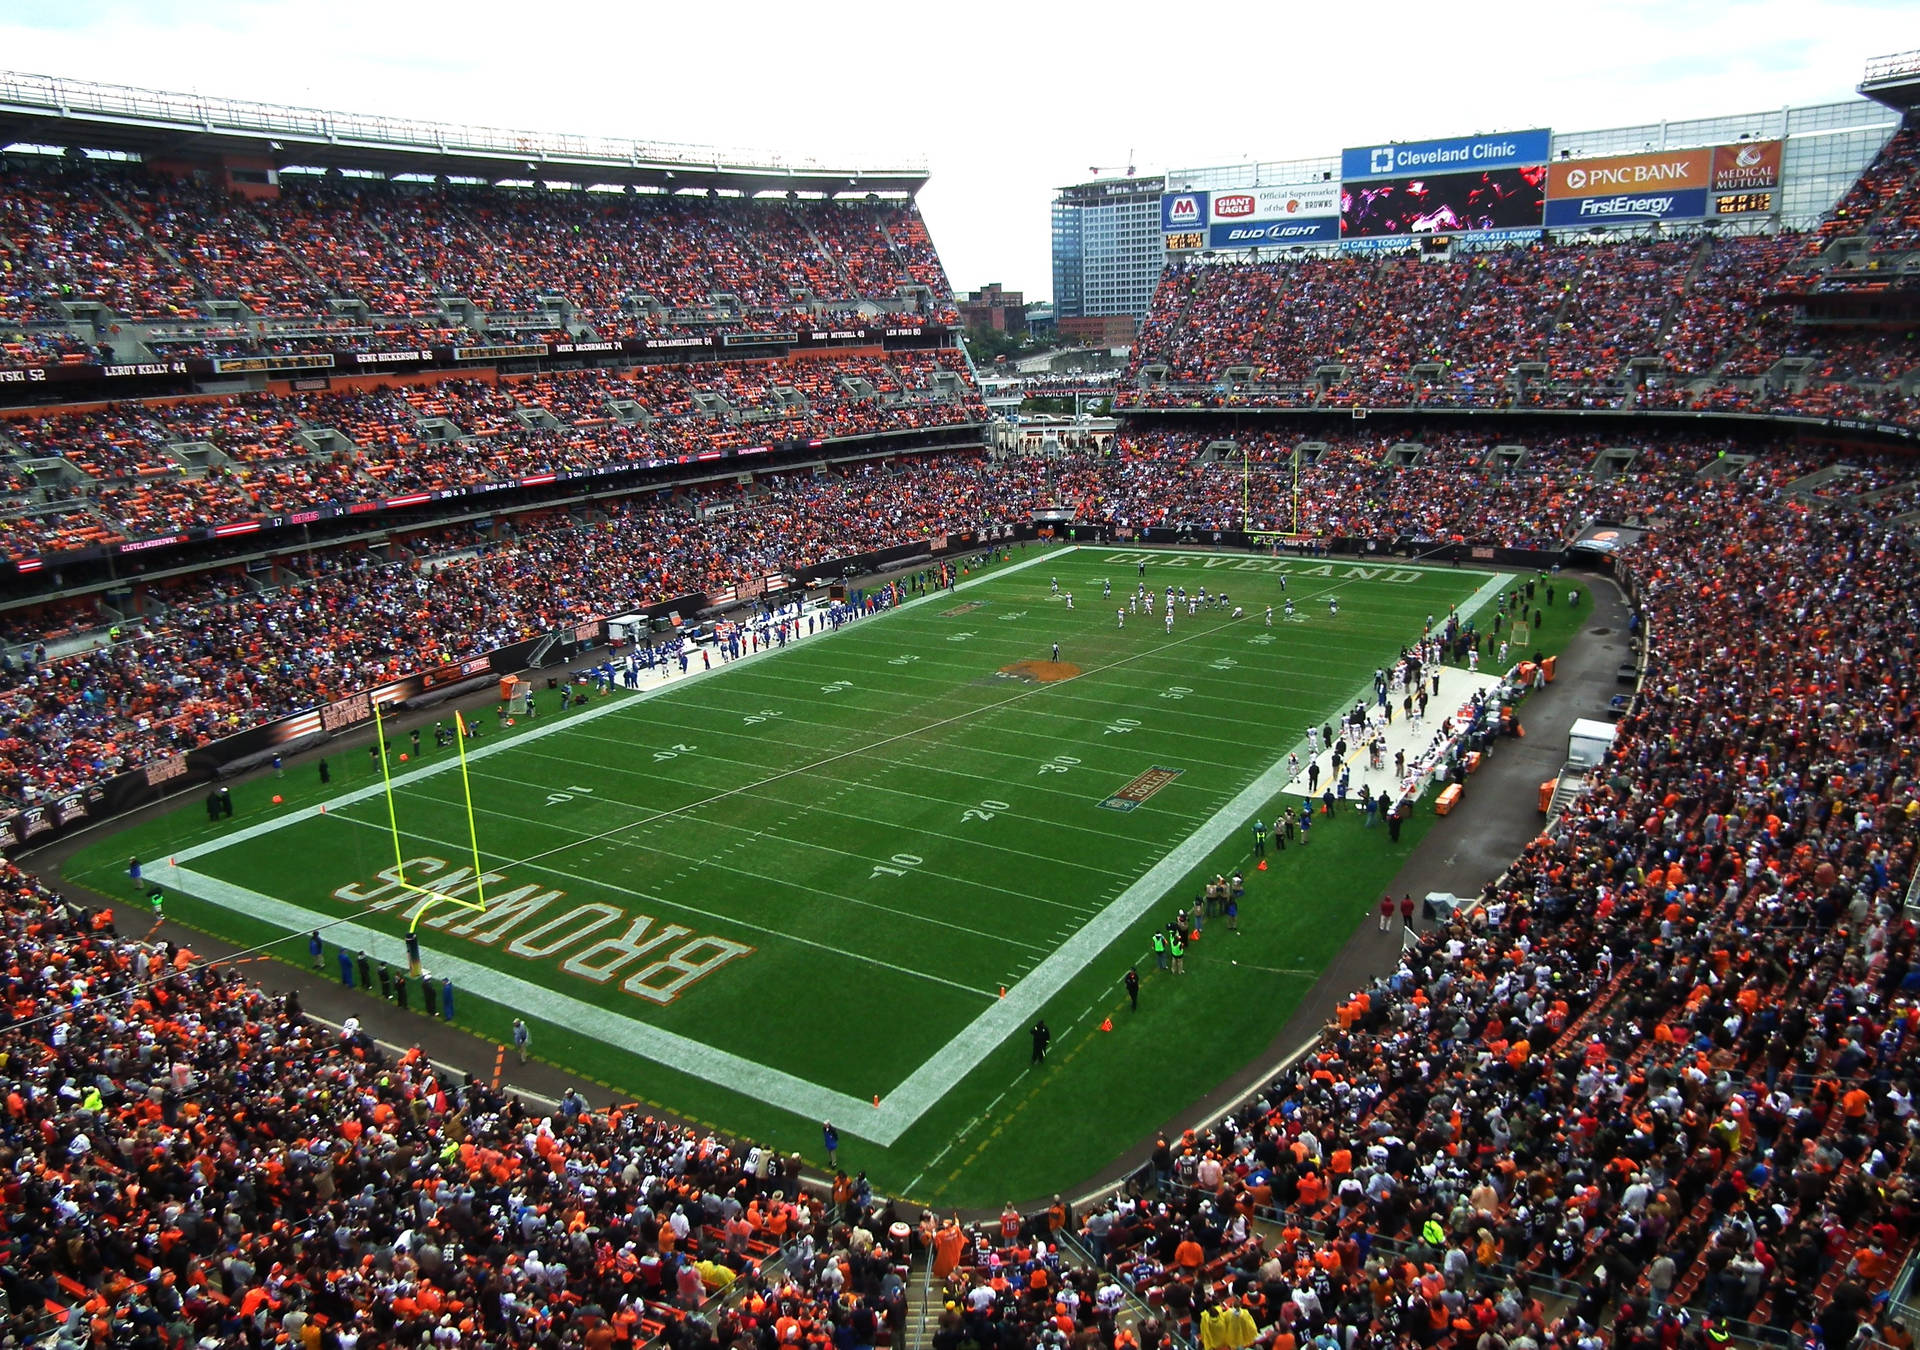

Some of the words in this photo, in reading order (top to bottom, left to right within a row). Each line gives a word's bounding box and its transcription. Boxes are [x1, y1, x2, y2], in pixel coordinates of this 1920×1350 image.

[1397, 147, 1469, 166] Cleveland
[1472, 142, 1516, 159] Clinic
[1590, 166, 1632, 185] PNC
[1634, 162, 1690, 181] BANK
[1717, 167, 1773, 179] MEDICAL
[1716, 178, 1773, 190] MUTUAL
[1259, 191, 1288, 200] Official
[1288, 188, 1338, 200] Supermarket
[1218, 197, 1250, 207] GIANT
[1264, 204, 1272, 212] of
[1273, 204, 1285, 212] the
[1304, 200, 1333, 210] BROWNS
[1580, 197, 1674, 215] FirstEnergy
[1218, 205, 1250, 214] EAGLE
[1229, 228, 1266, 240] BUD
[1271, 225, 1321, 237] LIGHT
[1351, 240, 1375, 249] CALL
[1376, 238, 1409, 247] TODAY
[830, 331, 856, 339] MITCHELL
[857, 330, 865, 338] 49
[556, 343, 574, 353] MIKE
[613, 341, 623, 350] 74
[646, 340, 658, 348] JOE
[704, 337, 713, 346] 64
[357, 353, 378, 363] GENE
[378, 351, 419, 362] HICKERSON
[422, 351, 433, 360] 66
[30, 369, 46, 381] 52
[104, 365, 137, 377] LEROY
[138, 363, 169, 375] KELLY
[172, 362, 188, 374] 44
[485, 483, 498, 492] Ball
[508, 480, 516, 489] 21
[335, 507, 344, 516] 14
[274, 517, 283, 527] 17
[1103, 553, 1425, 584] CLEVELAND
[1158, 686, 1194, 700] 50
[1105, 717, 1143, 735] 40
[652, 742, 698, 763] 20
[1039, 755, 1081, 775] 30
[545, 785, 594, 807] 10
[64, 798, 78, 810] 82
[963, 799, 1010, 822] 20
[28, 811, 42, 823] 77
[870, 852, 924, 879] 10
[331, 856, 757, 1006] BROWNS
